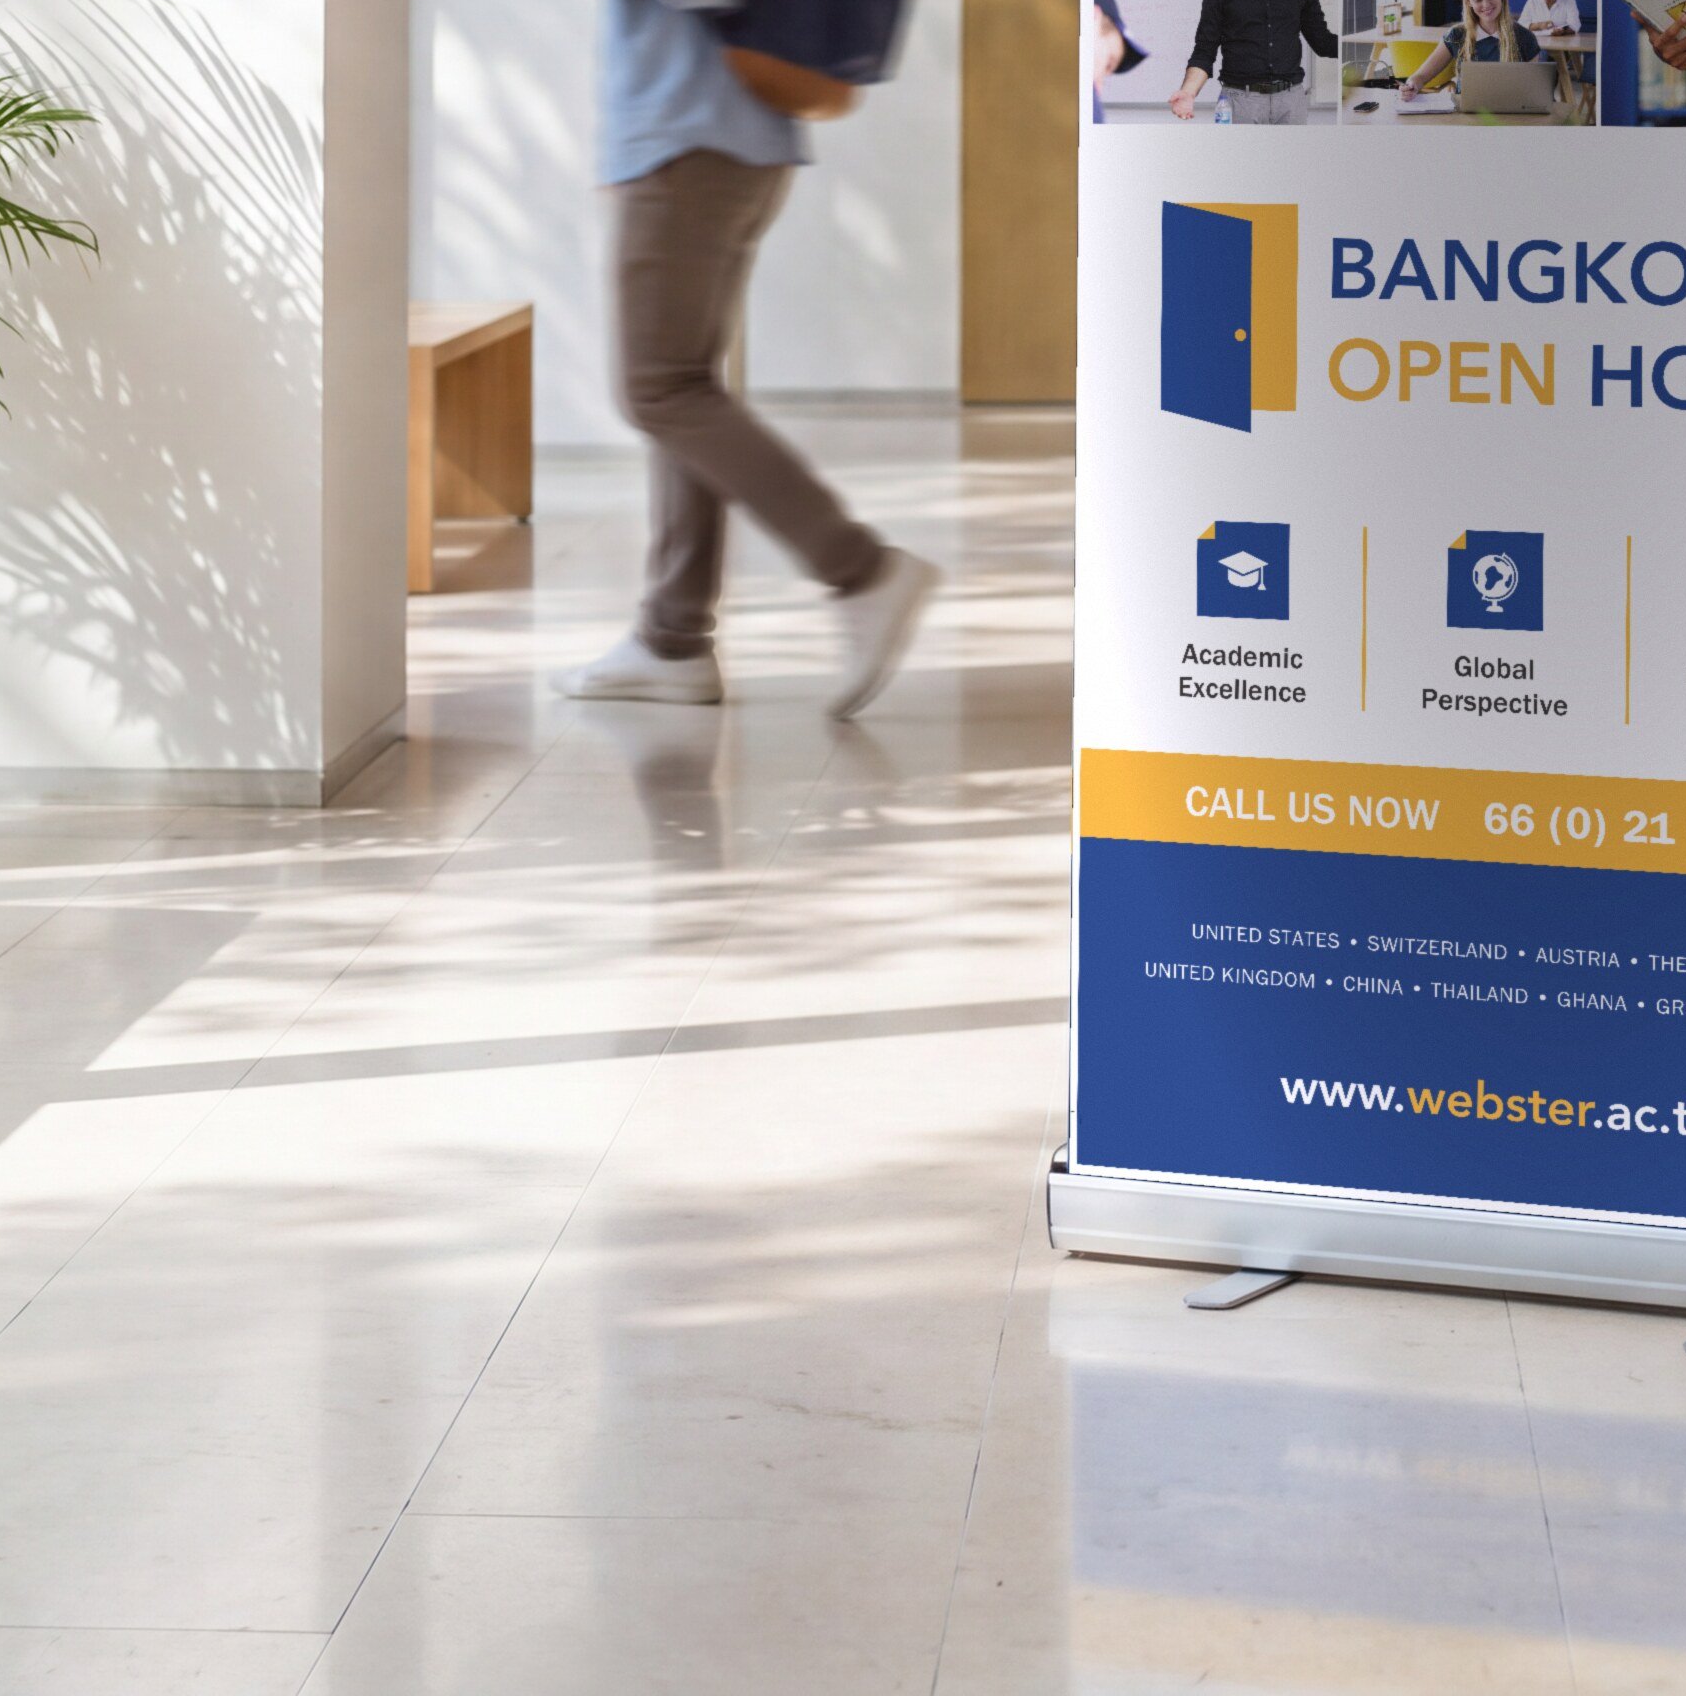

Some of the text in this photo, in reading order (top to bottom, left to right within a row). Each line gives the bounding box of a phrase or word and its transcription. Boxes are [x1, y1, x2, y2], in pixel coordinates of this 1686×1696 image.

[1328, 337, 1556, 406] OPEN
[1181, 643, 1303, 670] Academic
[1454, 655, 1534, 681] Global
[1178, 676, 1307, 703] Excellence
[1422, 688, 1568, 717] Perspective
[1185, 786, 1275, 821] CALL
[1288, 791, 1336, 824] US
[1349, 795, 1440, 831] NOW
[1484, 802, 1535, 837] 66
[1549, 806, 1606, 848] (0)
[1623, 809, 1676, 845] 21
[1192, 923, 1262, 944] UNITED
[1268, 928, 1340, 949] STATES
[1367, 935, 1508, 960] SWITZERLAND
[1535, 947, 1620, 968] AUSTRIA
[1144, 961, 1215, 981] UNITED
[1222, 967, 1315, 989] KINGDOM
[1343, 975, 1404, 996] CHINA
[1430, 982, 1529, 1004] THAILAND
[1557, 991, 1627, 1012] GHANA
